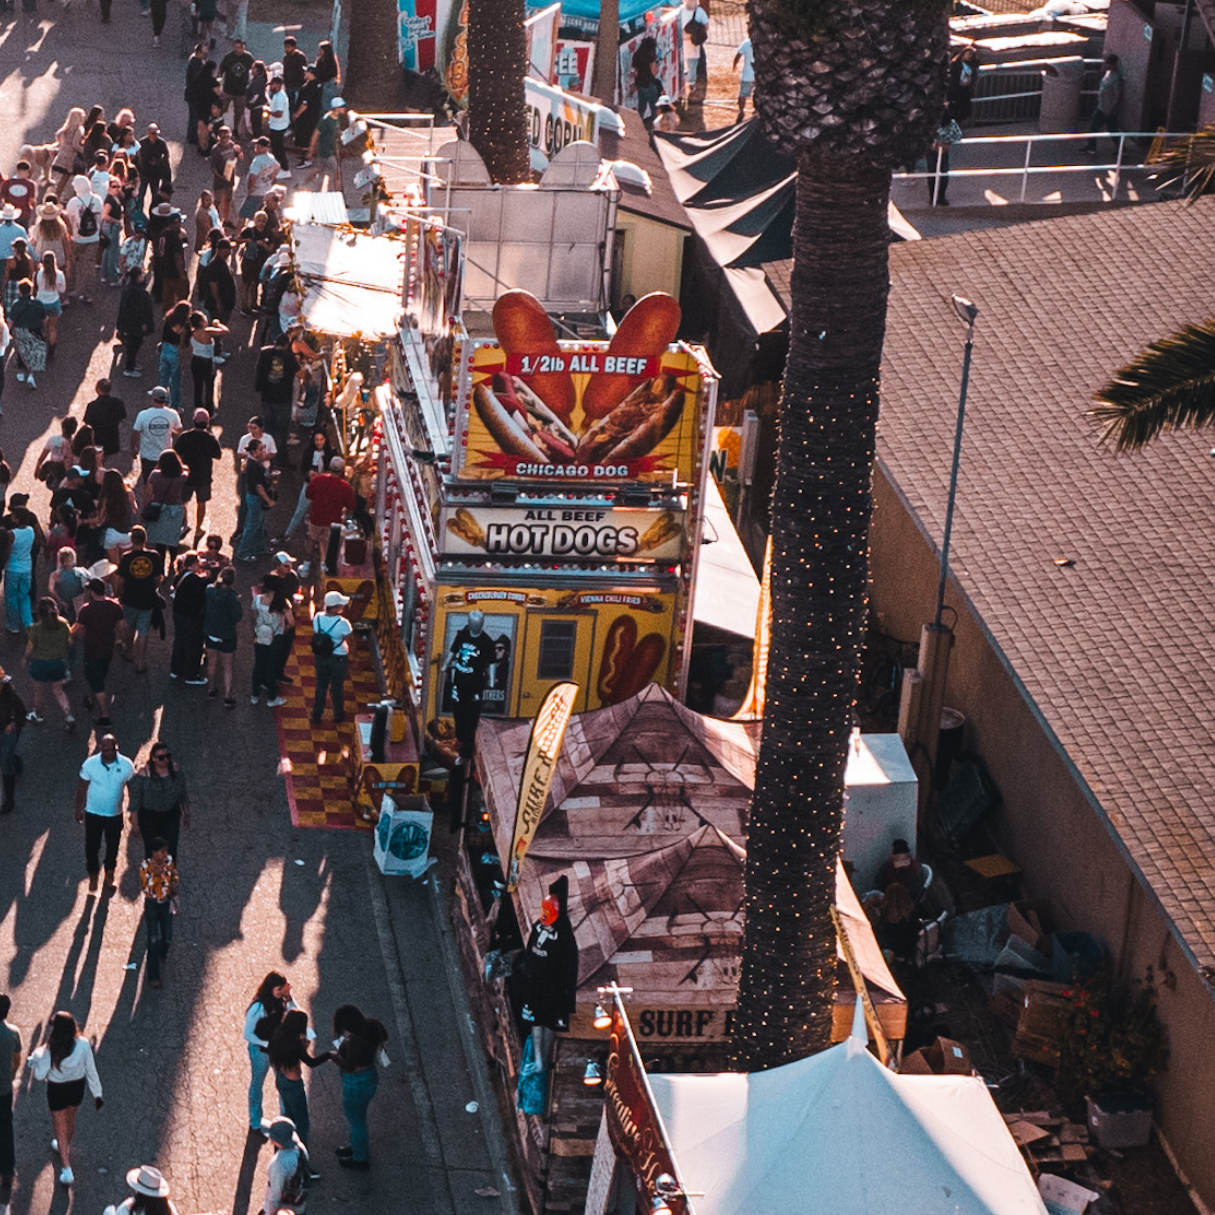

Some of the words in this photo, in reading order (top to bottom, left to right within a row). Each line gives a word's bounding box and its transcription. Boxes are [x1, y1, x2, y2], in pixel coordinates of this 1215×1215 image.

[520, 355, 565, 375] 1/2lb
[569, 354, 600, 372] ALL
[604, 356, 648, 375] BEEF
[515, 462, 589, 477] CHICAGO
[593, 464, 629, 477] DOG
[524, 511, 557, 521] ALL
[561, 511, 606, 522] BEEF
[487, 524, 550, 554] HOT
[552, 525, 639, 556] DOGS
[580, 594, 604, 604] VIENNA
[622, 595, 641, 605] FRIES
[639, 1009, 713, 1038] SURF
